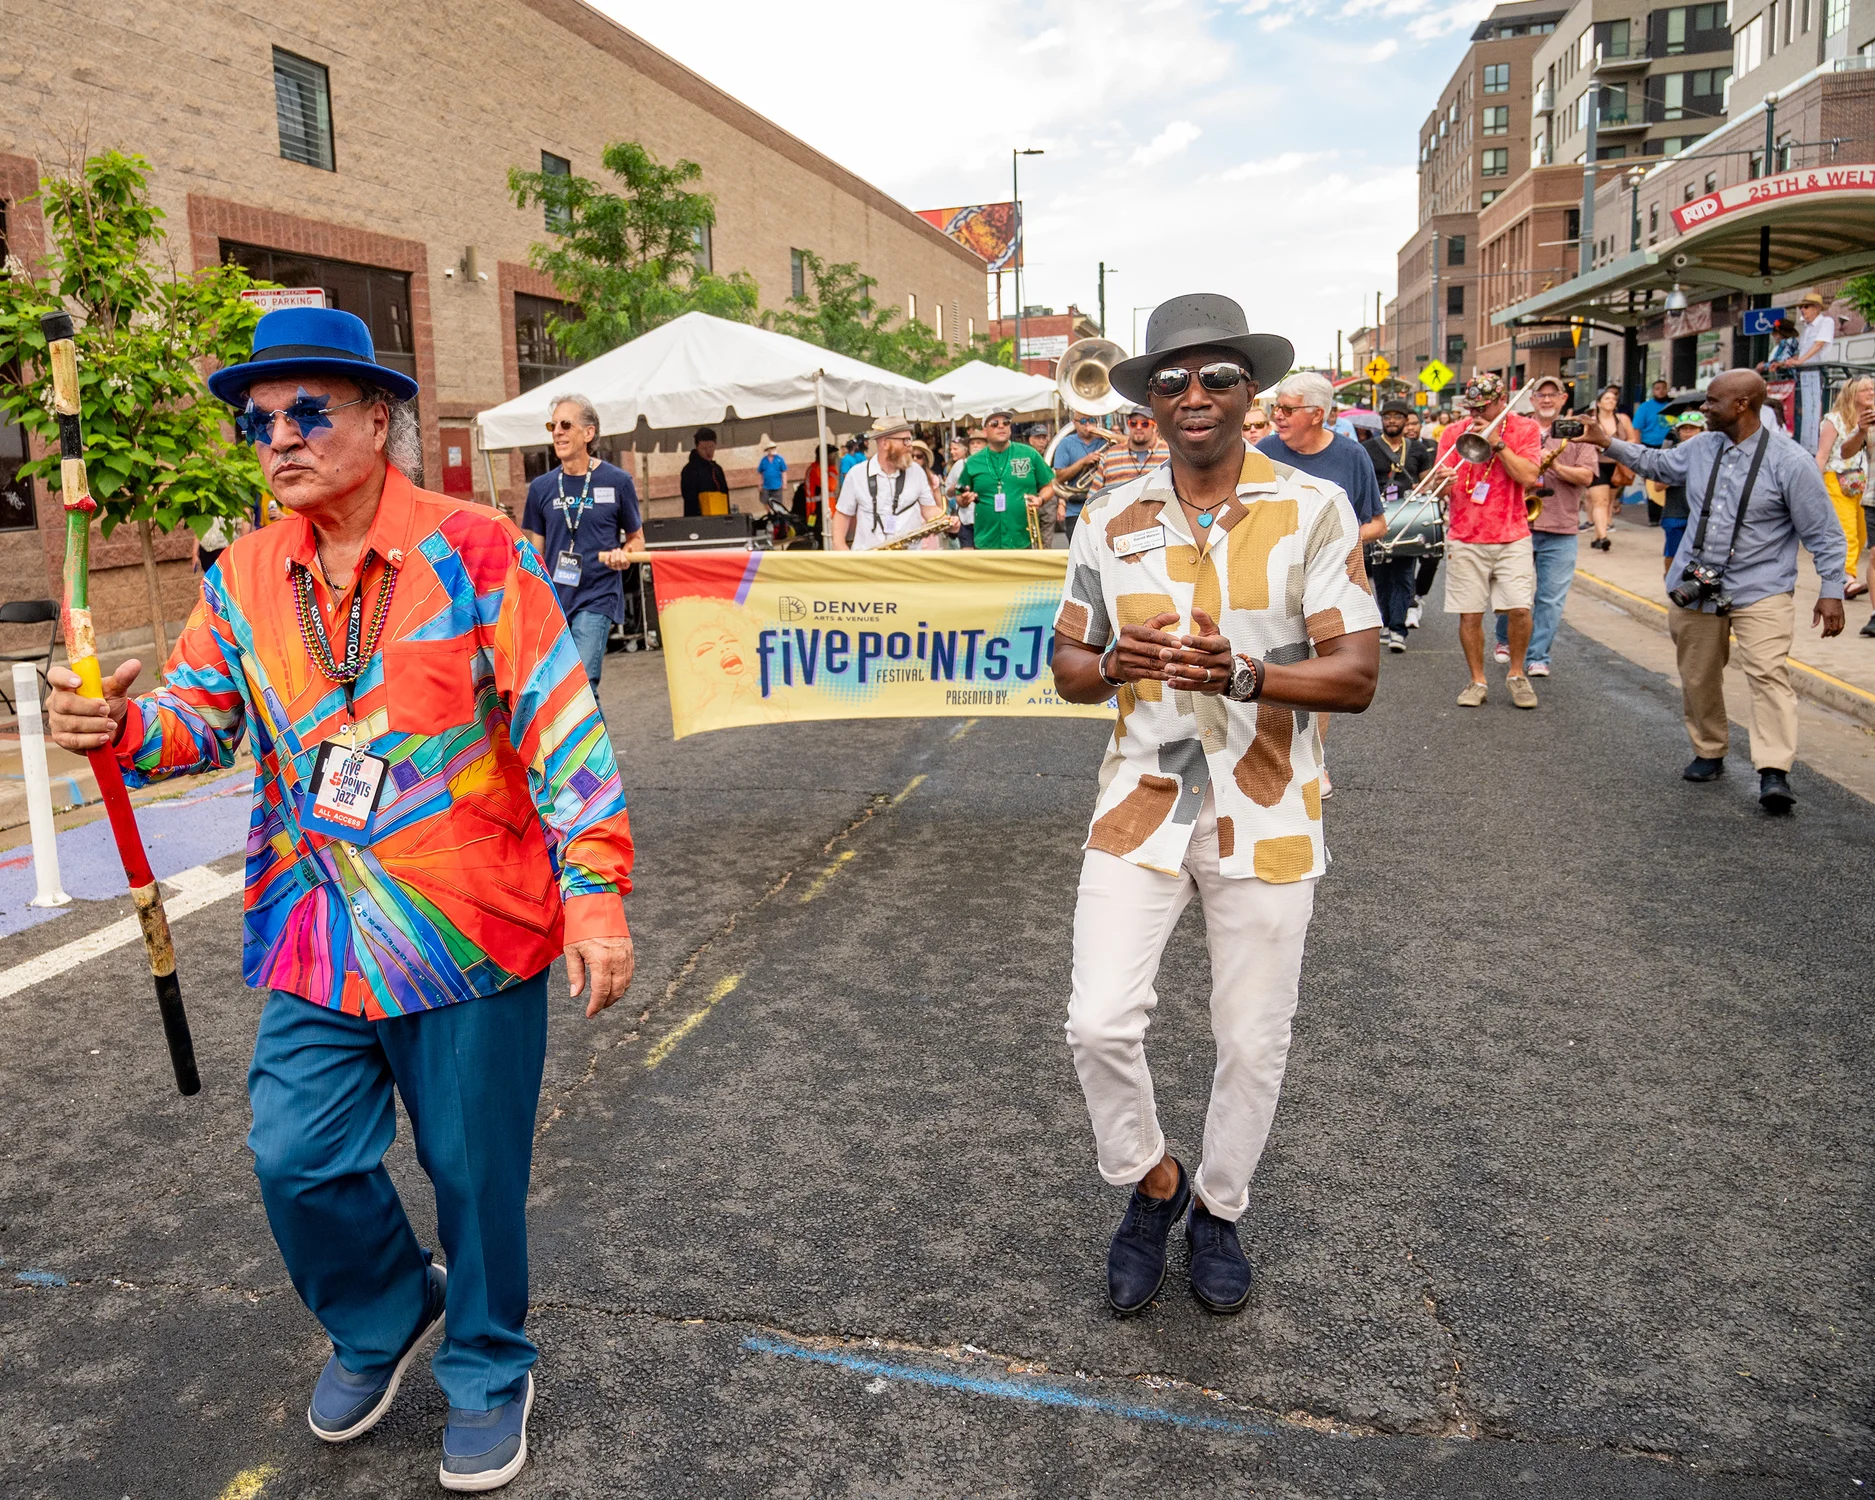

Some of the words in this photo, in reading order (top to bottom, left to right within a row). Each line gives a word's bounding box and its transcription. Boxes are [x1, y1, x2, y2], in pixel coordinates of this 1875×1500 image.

[1748, 177, 1799, 200] 25TH
[1806, 174, 1819, 188] &
[1681, 198, 1718, 225] RTD
[272, 297, 312, 306] PARKING
[558, 572, 577, 580] STAFF
[813, 601, 898, 615] DENVER
[876, 668, 925, 684] FESTIVAL
[946, 690, 993, 705] PRESENTED
[996, 690, 1010, 705] BY:
[318, 808, 332, 817] ALL
[334, 813, 361, 827] ACCESS
